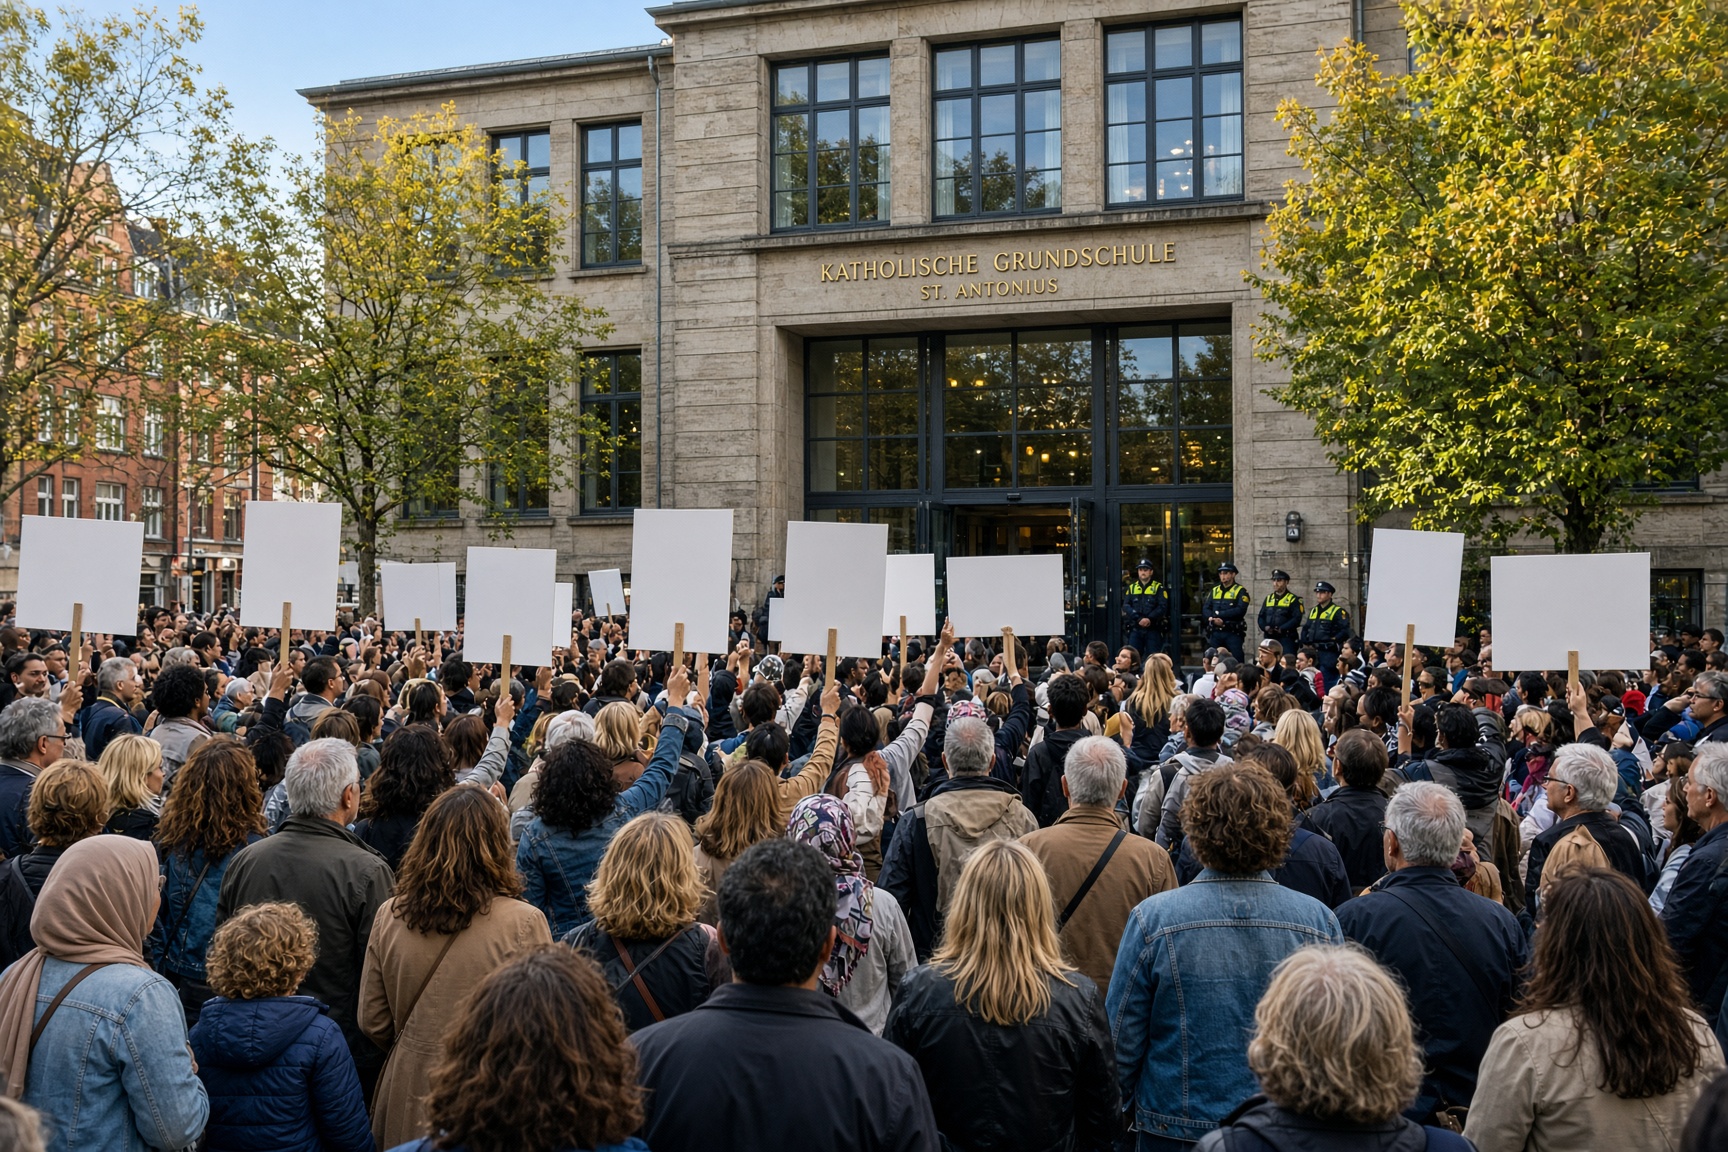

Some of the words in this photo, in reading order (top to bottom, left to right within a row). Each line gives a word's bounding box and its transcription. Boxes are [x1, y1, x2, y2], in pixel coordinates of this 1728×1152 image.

[821, 254, 978, 282] KATHOLISCHE
[993, 242, 1176, 272] GRUNDSCHULE
[920, 284, 947, 300] ST.
[955, 278, 1058, 299] ANTONIUS
